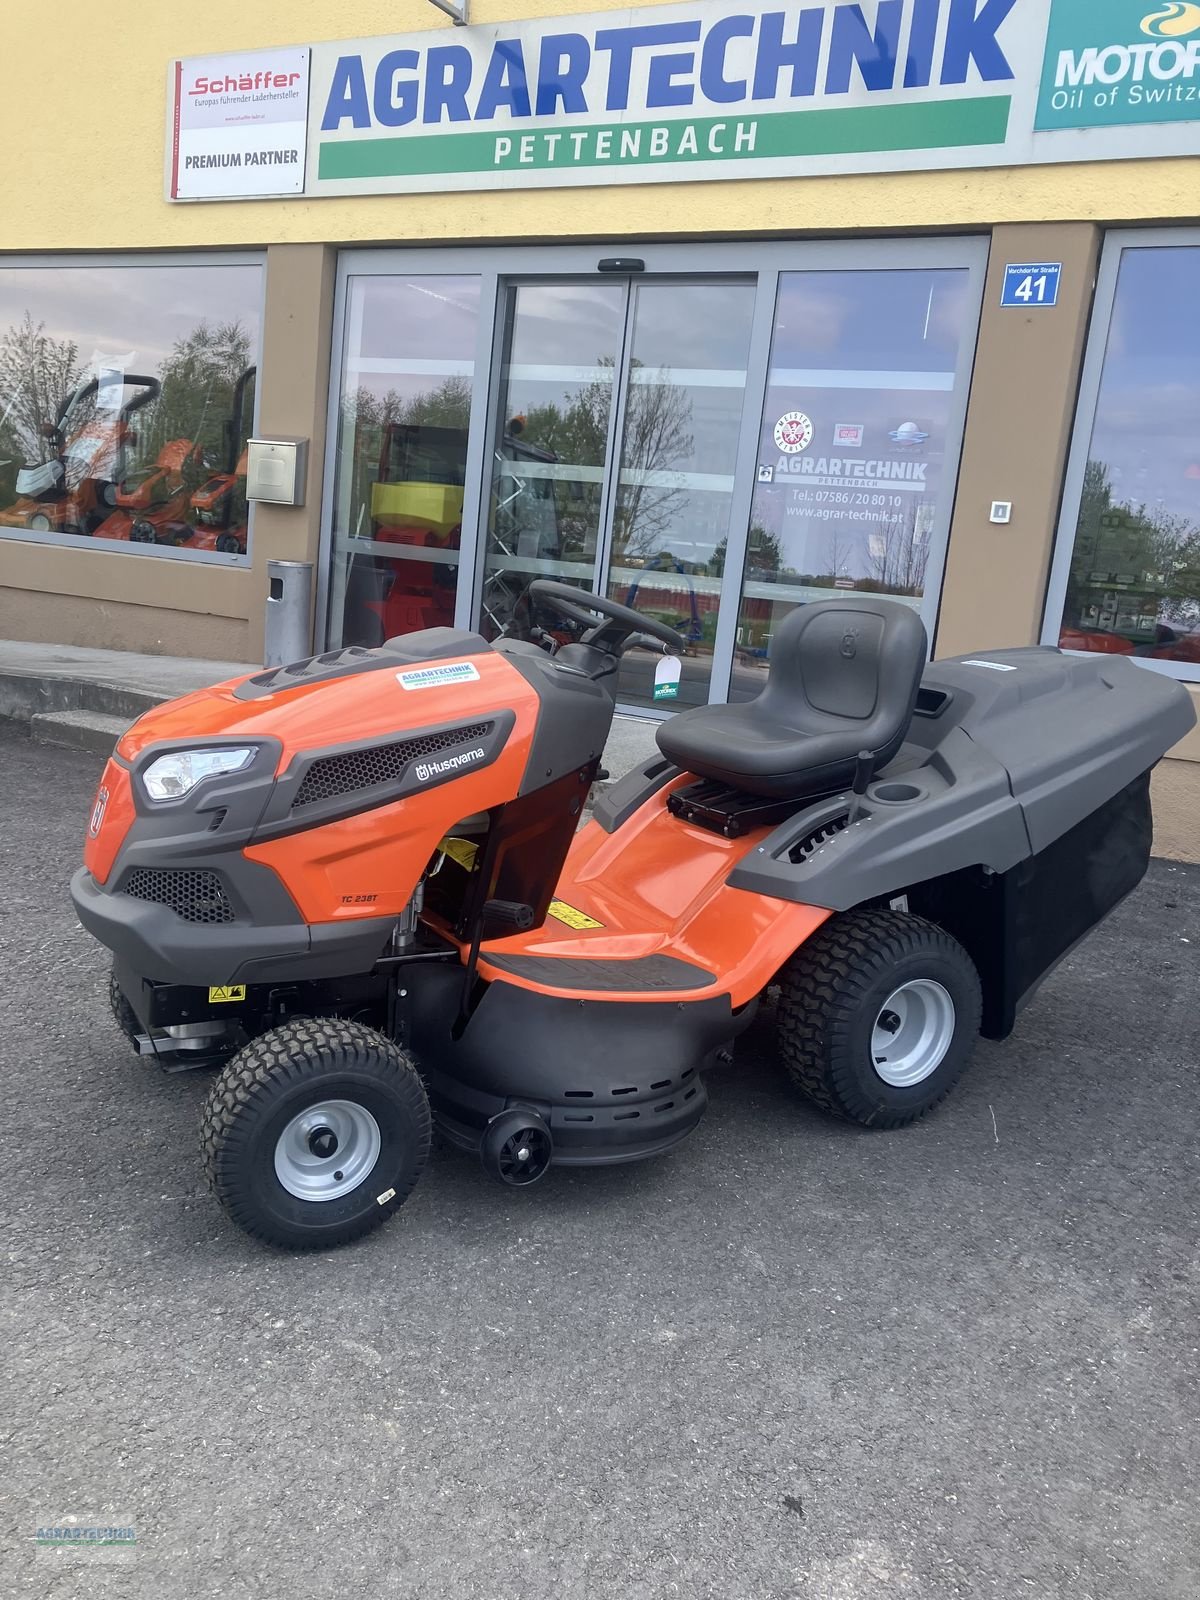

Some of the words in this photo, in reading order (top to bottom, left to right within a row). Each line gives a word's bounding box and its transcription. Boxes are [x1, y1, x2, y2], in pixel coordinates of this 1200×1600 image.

[320, 0, 1017, 131] AGRARTECHNIK
[188, 71, 300, 95] Schäffer
[194, 98, 219, 108] Europas
[220, 94, 251, 105] führender
[252, 90, 299, 102] Laderhersteller
[1051, 90, 1083, 110] Oil
[1094, 86, 1119, 107] of
[1128, 83, 1200, 105] Switz
[494, 121, 758, 164] PETTENBACH
[185, 153, 242, 169] PREMIUM
[244, 149, 298, 166] PARTNER
[1014, 275, 1047, 301] 41
[778, 413, 811, 428] MEISTER
[775, 455, 928, 480] AGRARTECHNIK
[818, 477, 878, 487] PETTENBACH
[792, 489, 814, 501] Tel.:
[871, 494, 885, 506] 80
[888, 495, 902, 507] 10
[786, 506, 904, 523] www.agrar-technik.at
[402, 664, 472, 680] AGRARTECHNIK
[427, 747, 485, 776] Husqvarna
[354, 895, 378, 903] 238T
